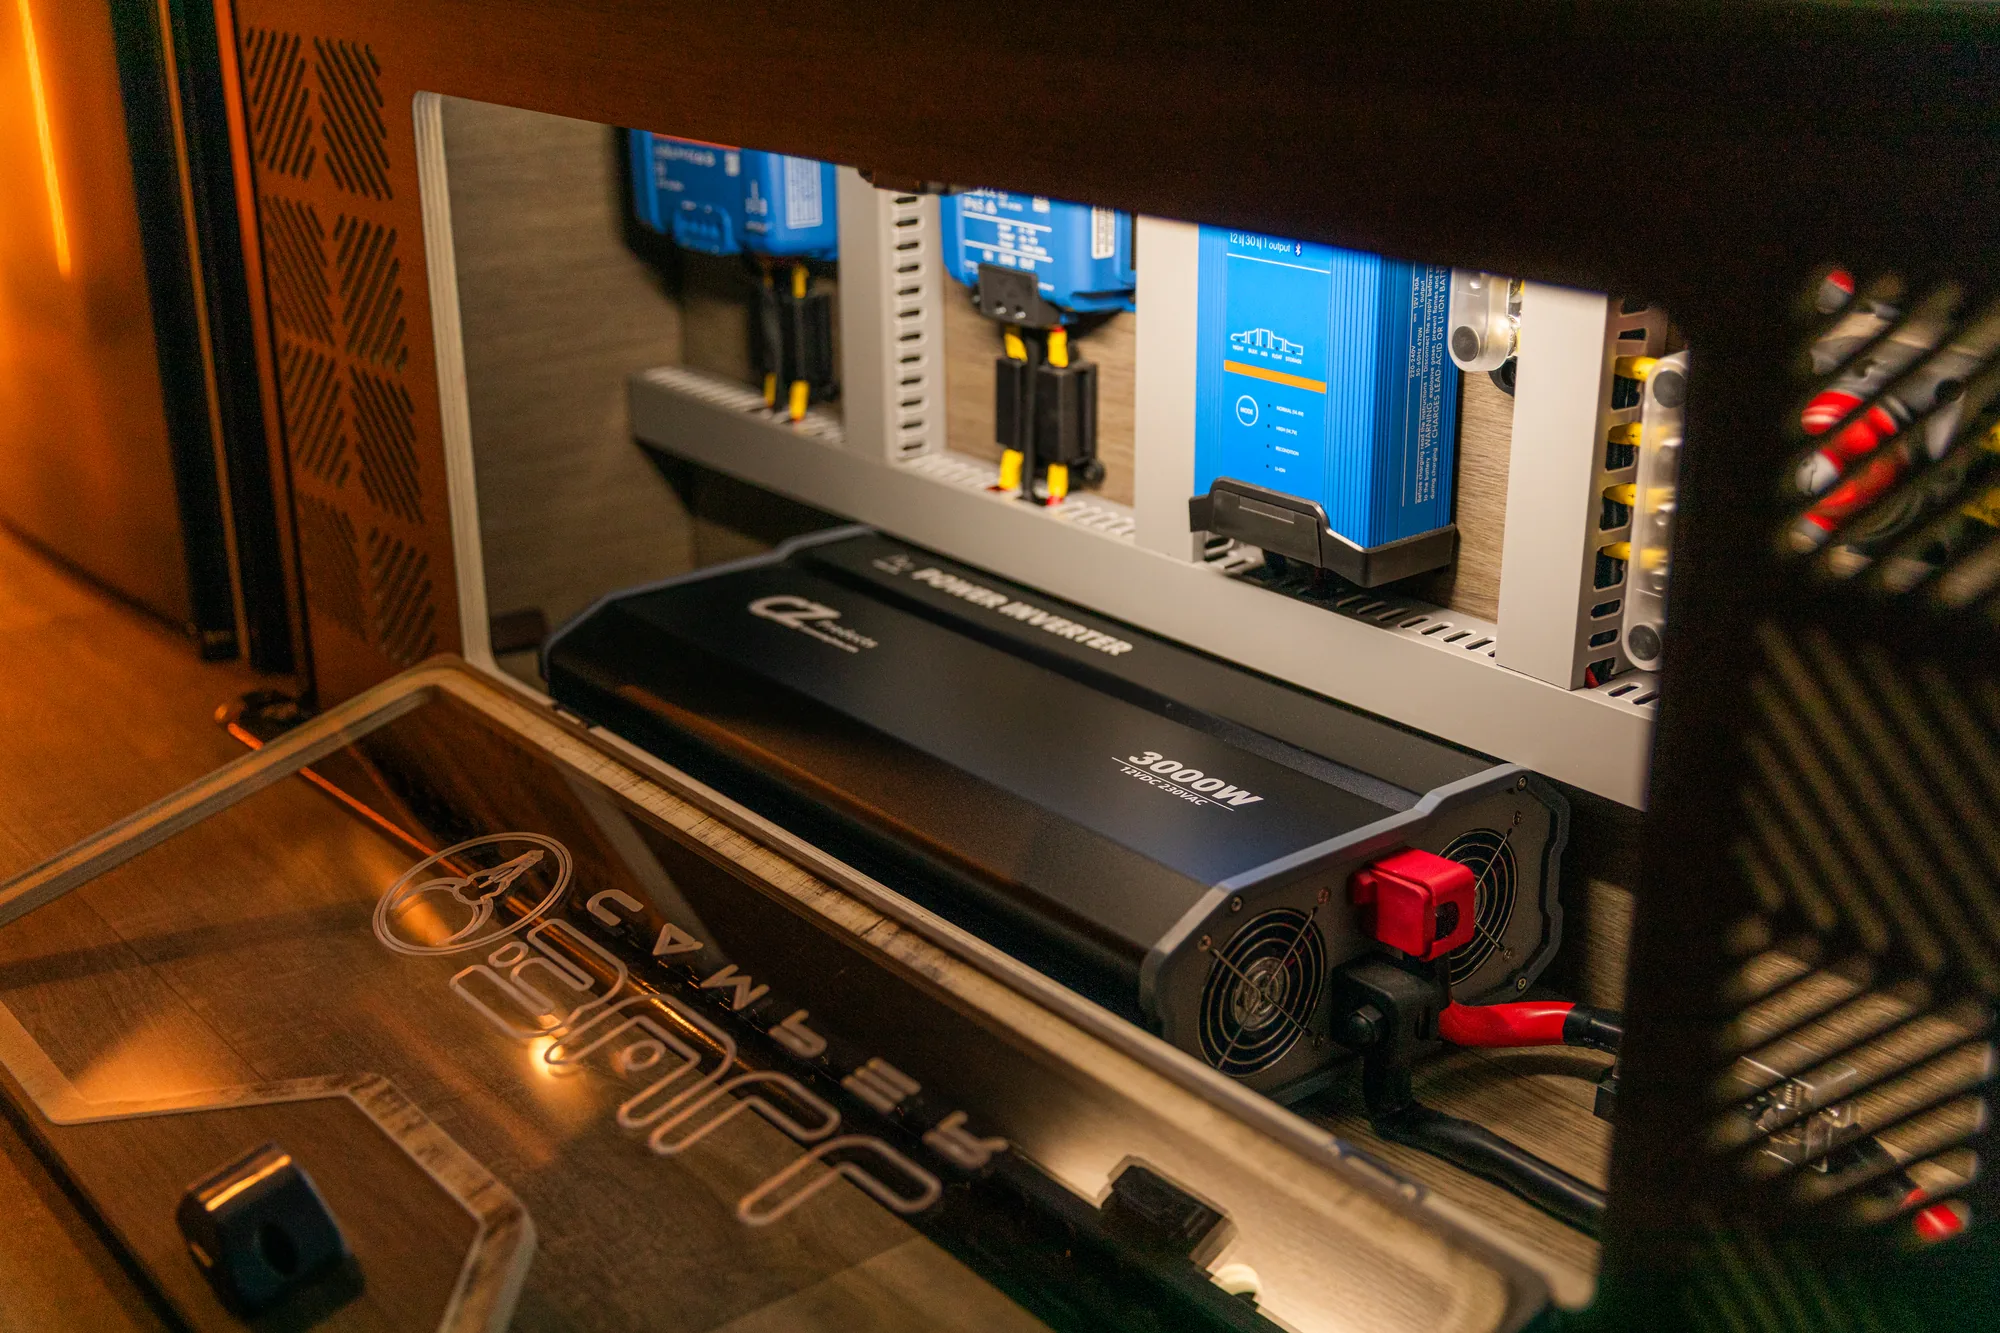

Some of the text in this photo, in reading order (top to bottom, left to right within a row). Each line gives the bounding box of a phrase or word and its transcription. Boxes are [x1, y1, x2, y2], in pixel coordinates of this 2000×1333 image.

[1268, 242, 1290, 253] output
[1437, 295, 1445, 324] LI-ION
[1436, 326, 1444, 341] OR
[1425, 402, 1433, 448] WARNING
[1432, 394, 1441, 438] CHARGES
[1431, 447, 1439, 476] charging
[912, 567, 1133, 657] POWER INVERTER
[1119, 766, 1208, 806] 12VDC 230VAC
[1128, 751, 1264, 806] 3000W
